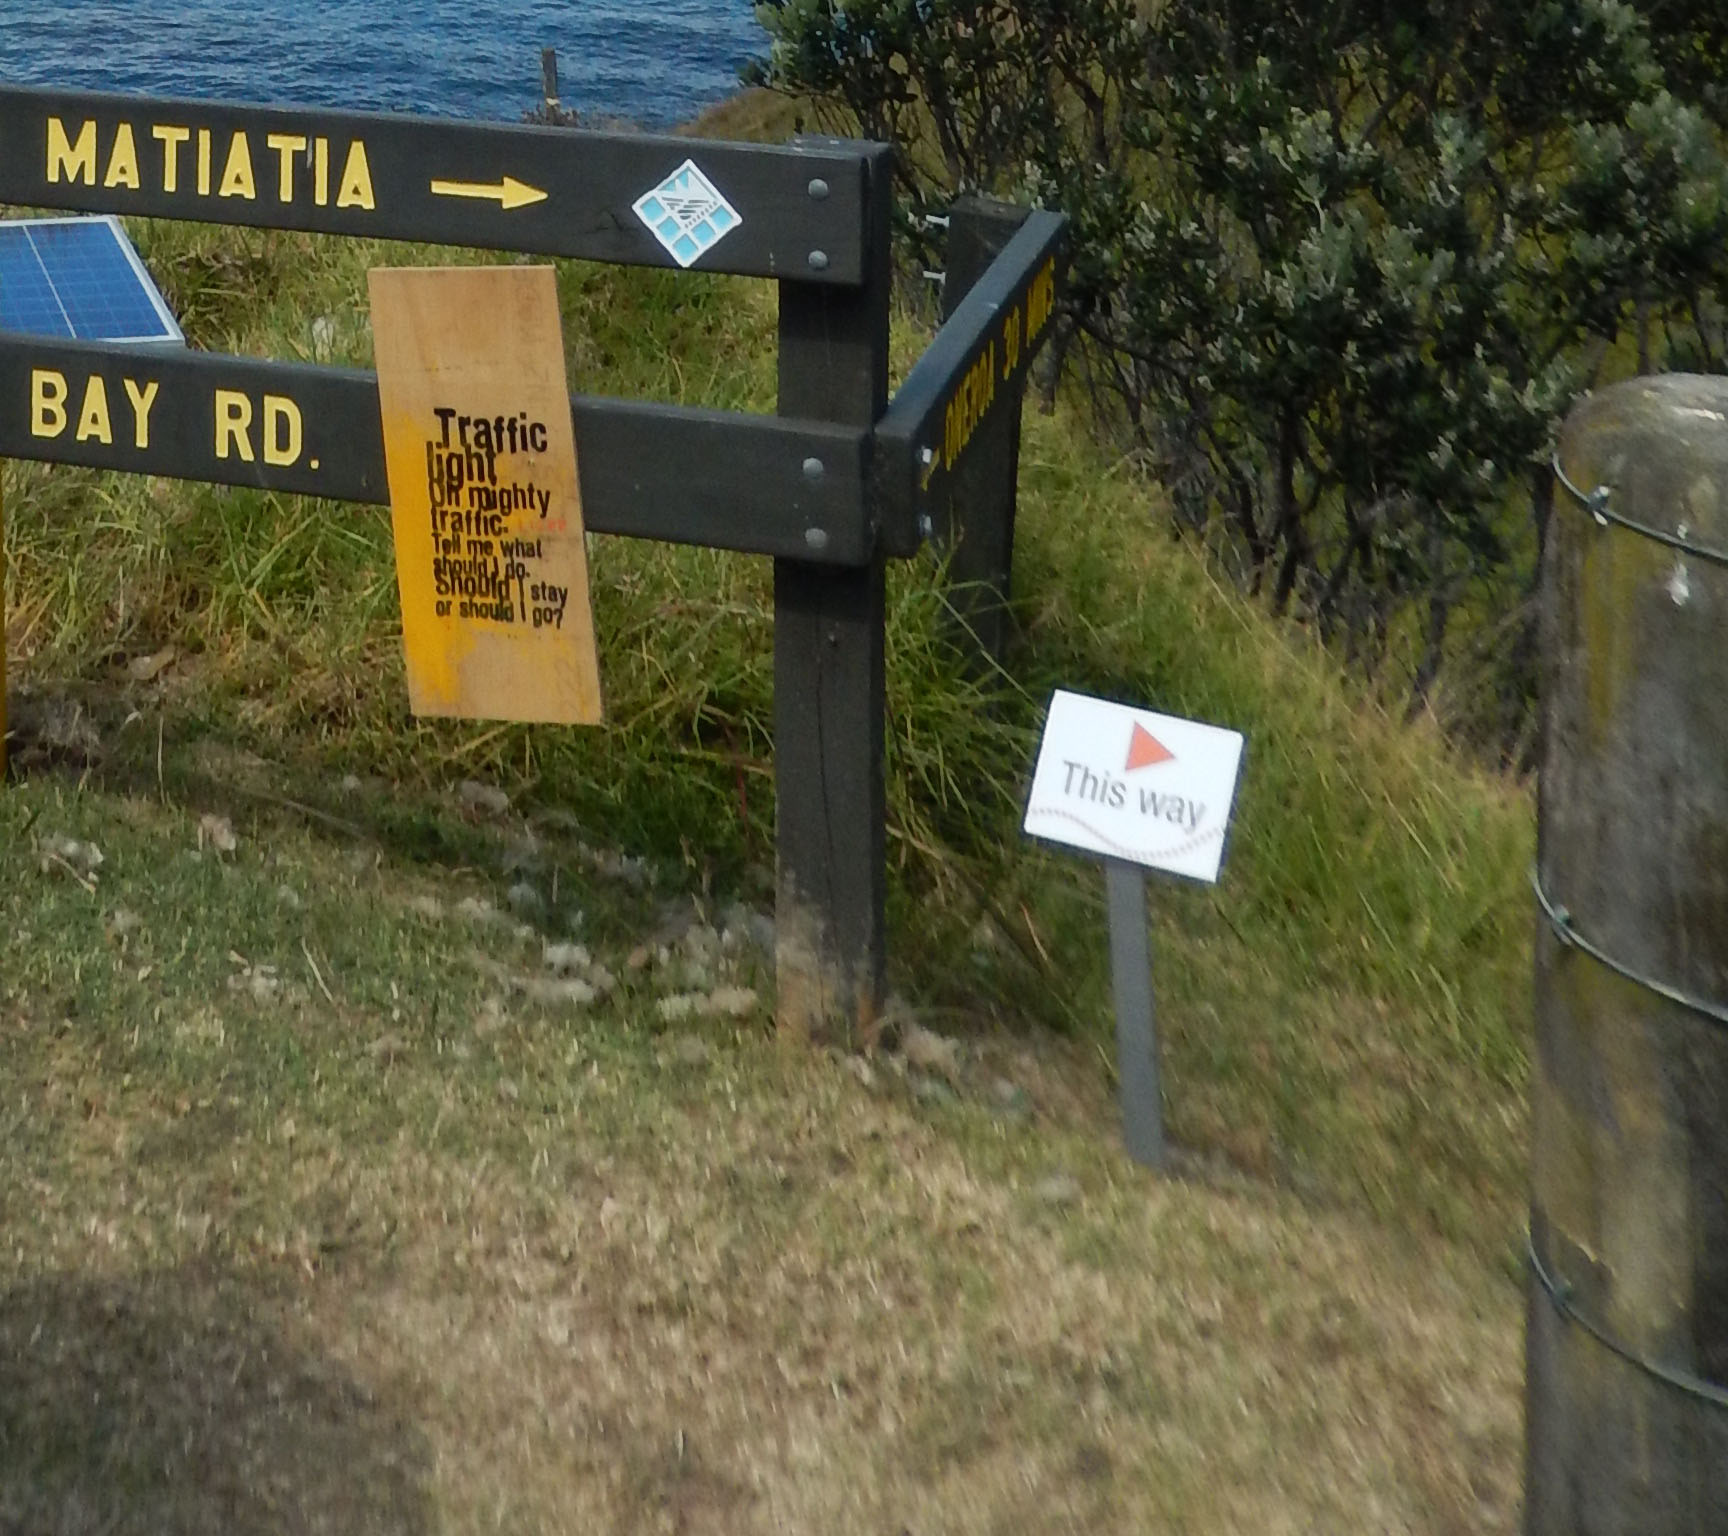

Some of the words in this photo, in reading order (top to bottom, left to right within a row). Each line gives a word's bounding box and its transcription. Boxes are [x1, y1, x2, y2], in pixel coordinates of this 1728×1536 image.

[47, 116, 376, 210] MATIATIA
[30, 368, 160, 448] BAY
[214, 389, 320, 470] RD.
[433, 407, 548, 454] Traffic
[426, 441, 497, 493] light
[468, 482, 551, 519] mighty
[431, 505, 509, 536] traffic.
[431, 532, 461, 555] Tell
[467, 540, 494, 556] me
[500, 537, 543, 559] what
[433, 555, 489, 576] should
[506, 560, 531, 580] do.
[530, 581, 568, 609] stay
[435, 600, 452, 616] or
[459, 598, 514, 623] should
[532, 607, 563, 630] go?
[1062, 759, 1126, 808] This
[1139, 786, 1208, 835] way
